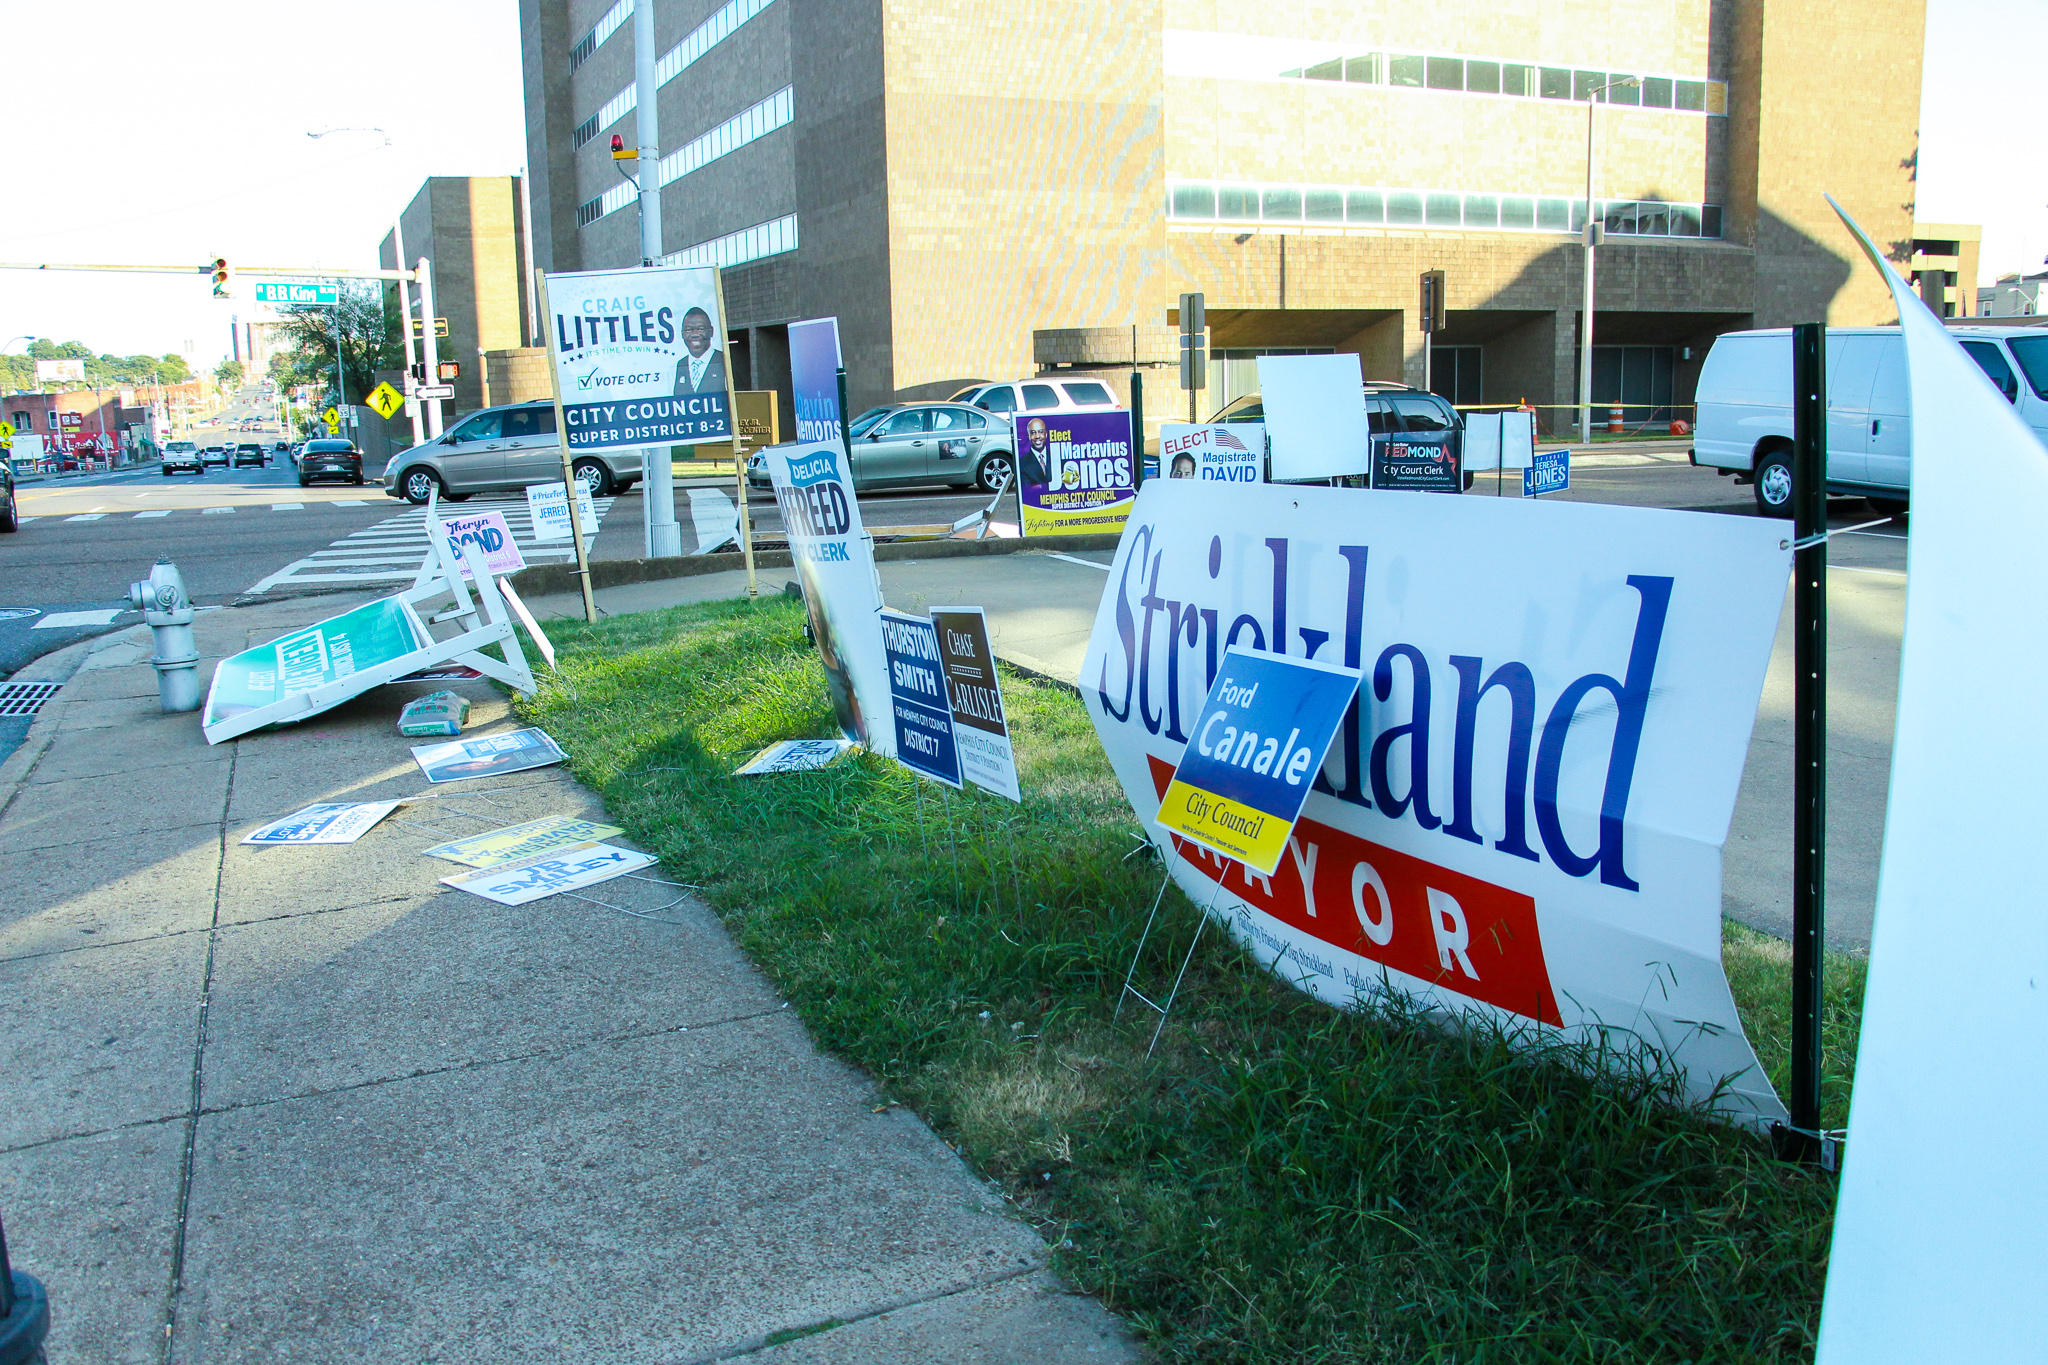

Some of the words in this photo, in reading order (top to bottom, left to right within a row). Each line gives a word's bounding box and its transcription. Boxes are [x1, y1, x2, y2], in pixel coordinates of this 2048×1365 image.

[290, 285, 317, 303] King
[582, 296, 646, 314] CRAIG
[557, 306, 675, 352] LITTLES
[602, 348, 620, 356] TIME
[596, 376, 624, 387] VOTE
[628, 373, 651, 384] OCT
[653, 372, 660, 382] 3
[566, 406, 616, 426] CITY
[626, 396, 723, 420] COUNCIL
[570, 428, 620, 444] SUPER
[624, 422, 694, 440] DISTRICT
[700, 419, 725, 432] 8-2
[1048, 430, 1072, 442] Elect
[1061, 440, 1128, 460] Martavius
[1164, 430, 1210, 454] ELECT
[1048, 442, 1130, 492] Jones
[1202, 452, 1256, 464] Magistrate
[1536, 460, 1558, 470] TERESA
[792, 458, 834, 480] DELICIA
[1202, 466, 1257, 482] DAVID
[1400, 465, 1422, 475] Court
[1424, 465, 1444, 474] Clerk
[1526, 466, 1566, 487] JONES
[1040, 493, 1069, 506] MEMPHIS
[1070, 492, 1086, 503] CITY
[1086, 490, 1116, 502] COUNCIL
[540, 505, 567, 519] JERRED
[446, 518, 490, 535] Theryn
[1026, 518, 1055, 532] Fighting
[1069, 518, 1082, 526] MORE
[1082, 516, 1114, 525] PROGRESSIVE
[882, 620, 938, 662] THURSTON
[894, 660, 938, 697] SMITH
[1216, 678, 1259, 708] Ford
[902, 708, 920, 724] MEMPHIS
[920, 711, 928, 727] CITY
[928, 717, 949, 734] COUNCIL
[904, 728, 934, 756] DISTRICT
[934, 738, 939, 758] 7
[1198, 710, 1312, 786] Canale
[1186, 792, 1210, 825] City
[1212, 802, 1264, 840] Council
[488, 852, 628, 895] SMILEY
[516, 860, 570, 876] JB
[536, 878, 575, 892] JR
[1299, 947, 1334, 980] Strickland
